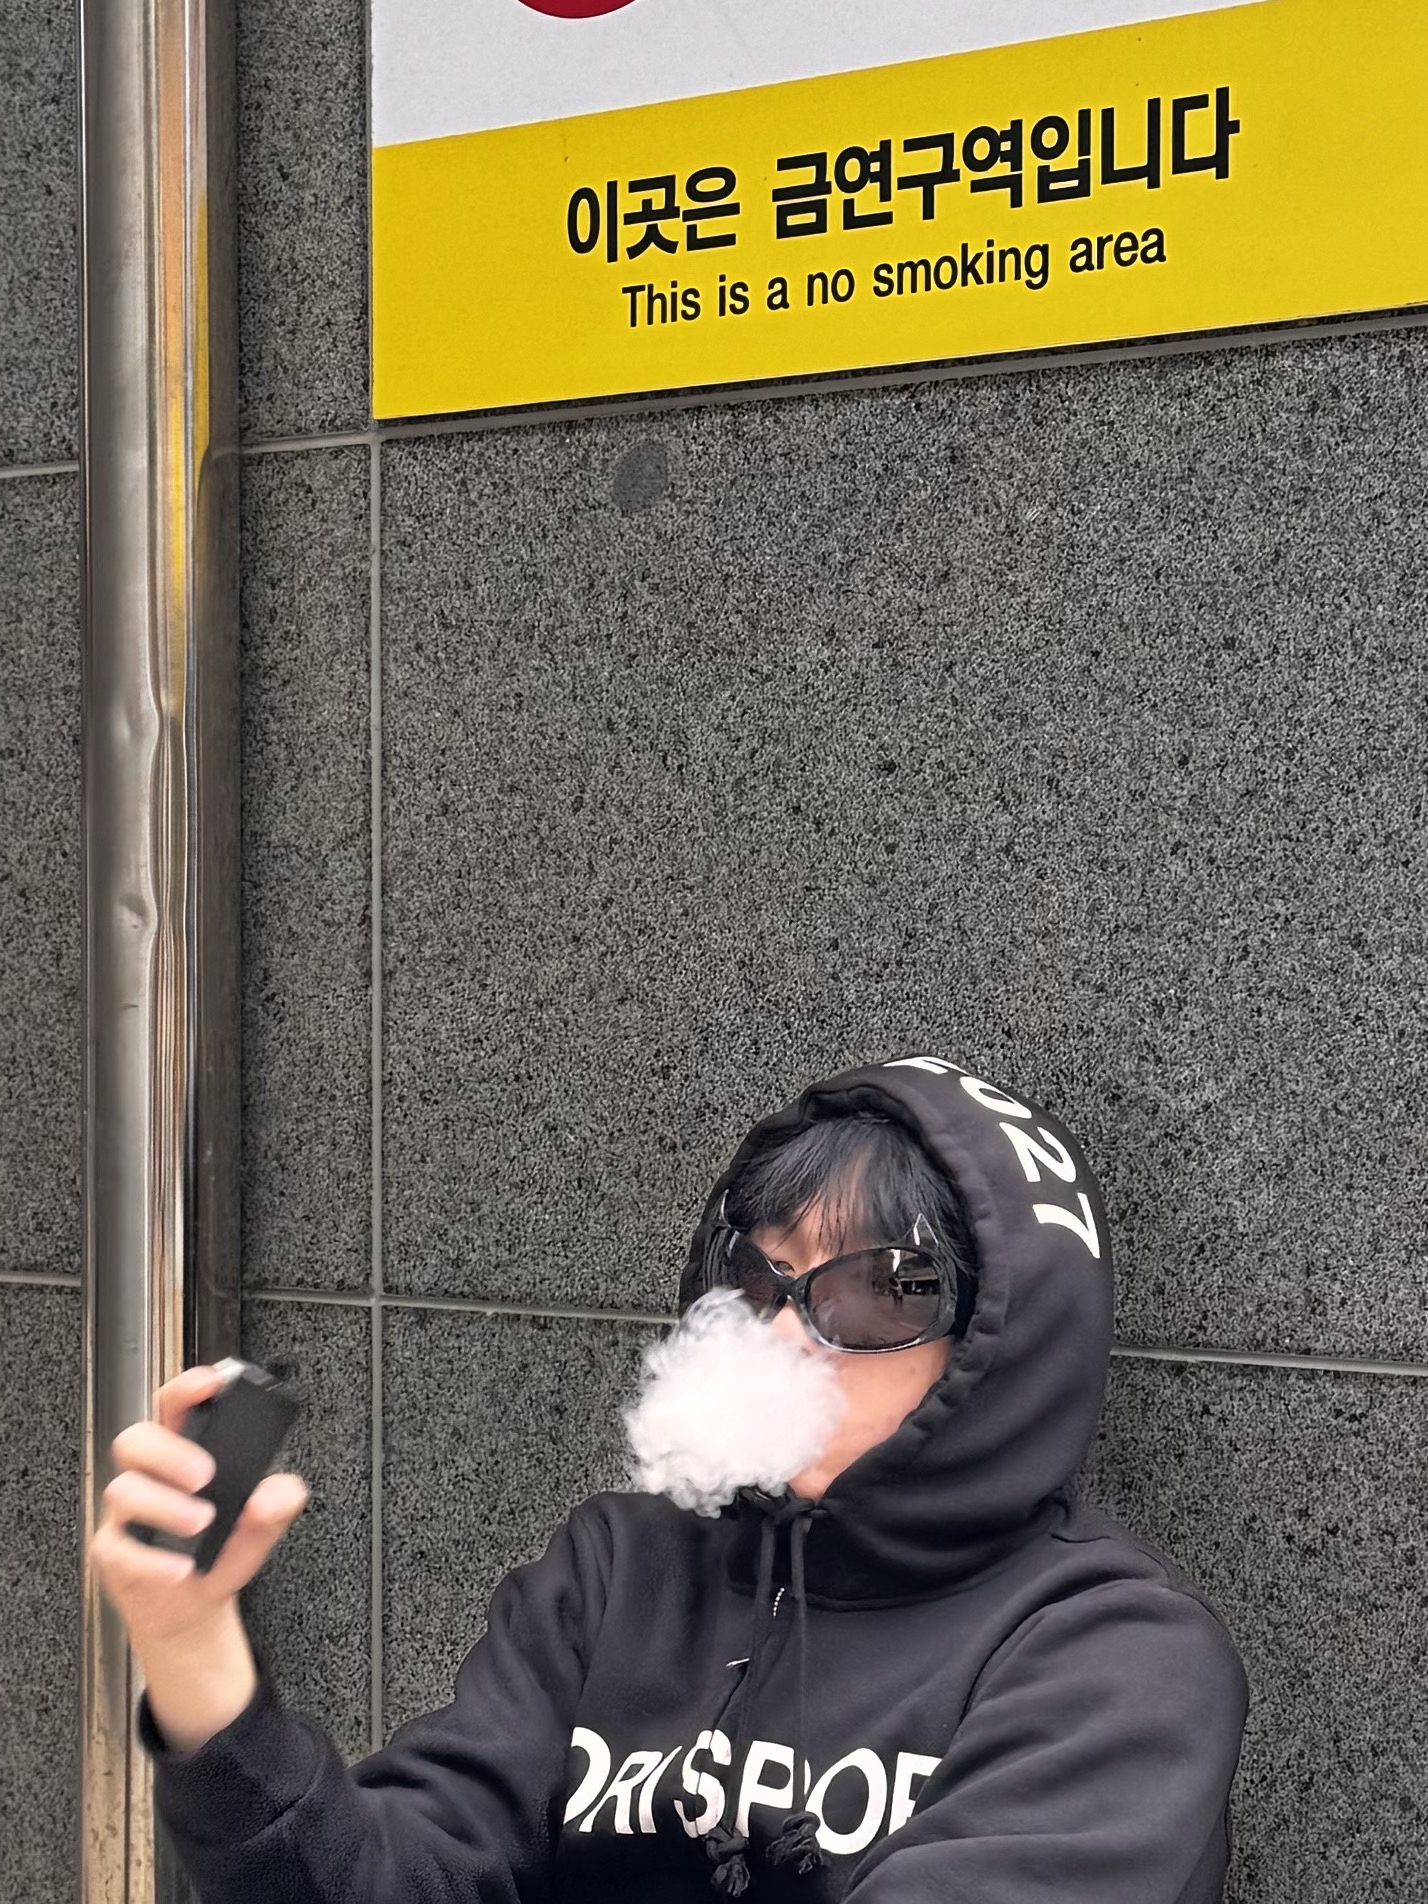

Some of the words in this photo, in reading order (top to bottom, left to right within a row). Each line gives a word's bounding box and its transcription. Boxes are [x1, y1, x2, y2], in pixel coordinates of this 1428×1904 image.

[566, 165, 741, 264] 이곳은
[771, 86, 1240, 240] 금연구역입니다
[622, 279, 701, 328] This
[717, 274, 749, 318] is
[765, 276, 791, 312] a
[806, 266, 856, 307] no
[872, 238, 1051, 297] smoking
[1068, 227, 1167, 275] area
